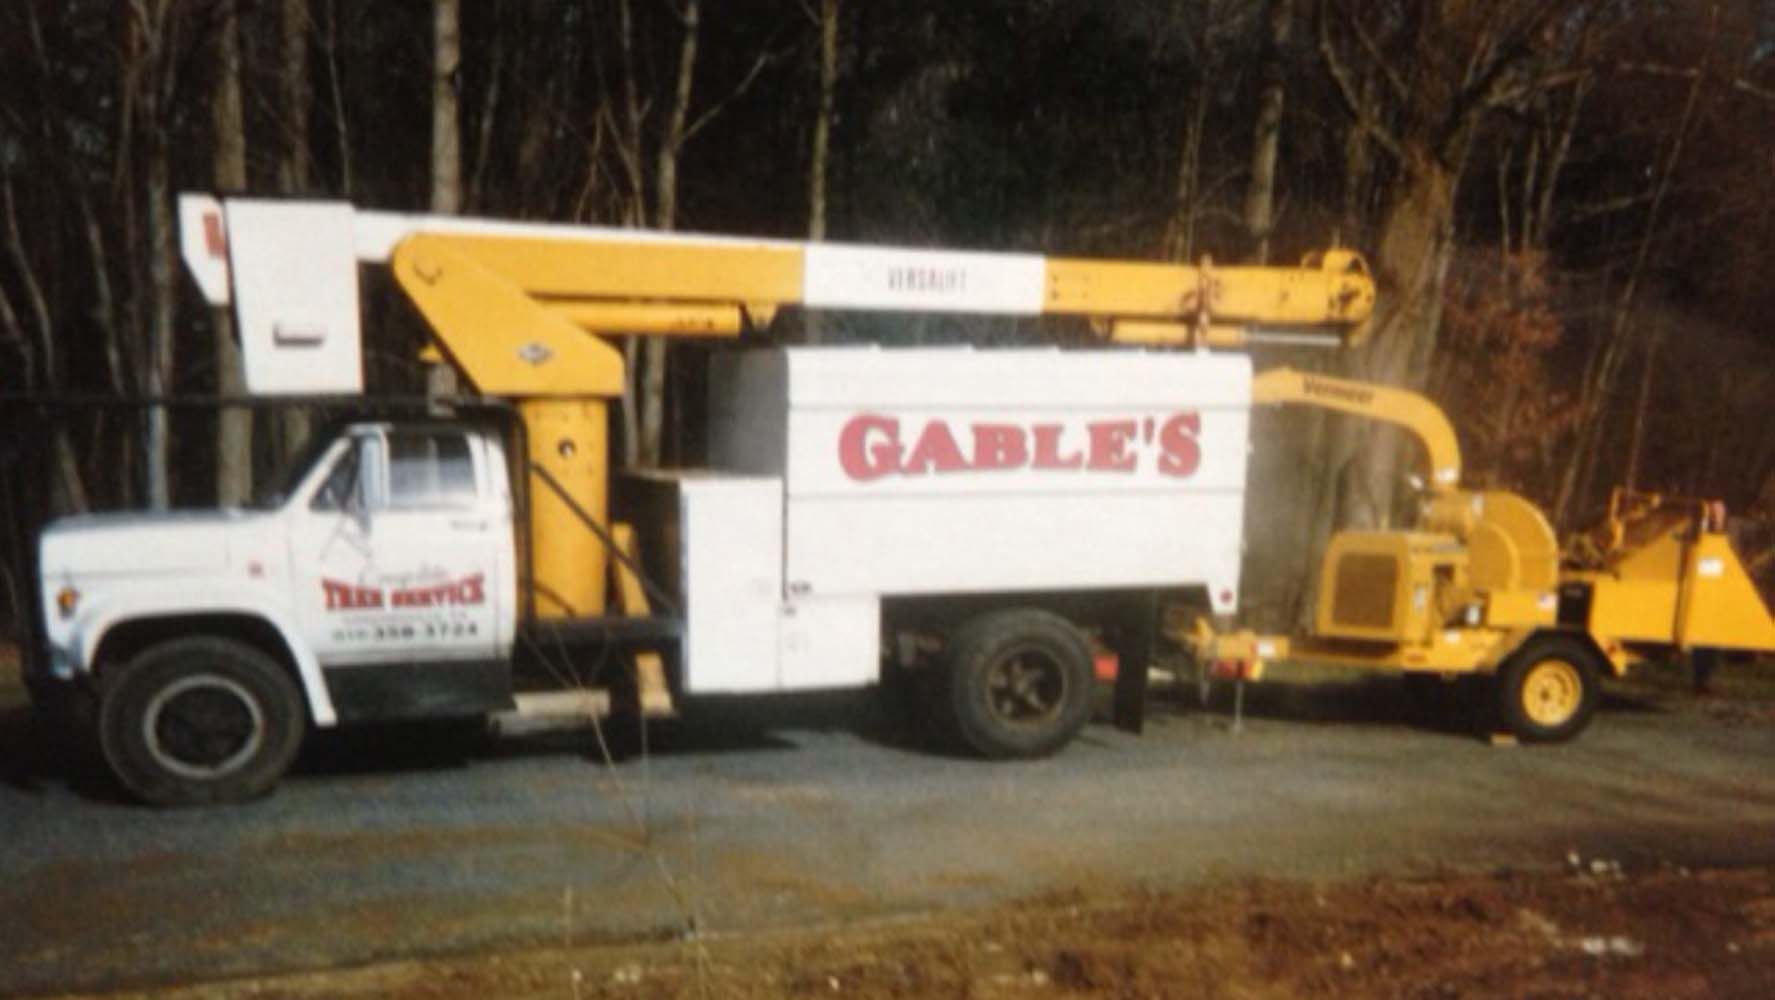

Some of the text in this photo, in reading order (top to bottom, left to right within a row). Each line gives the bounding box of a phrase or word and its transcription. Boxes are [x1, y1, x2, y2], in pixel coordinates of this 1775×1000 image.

[838, 410, 1202, 482] GABLE'S
[321, 573, 485, 613] TREE SERVICE
